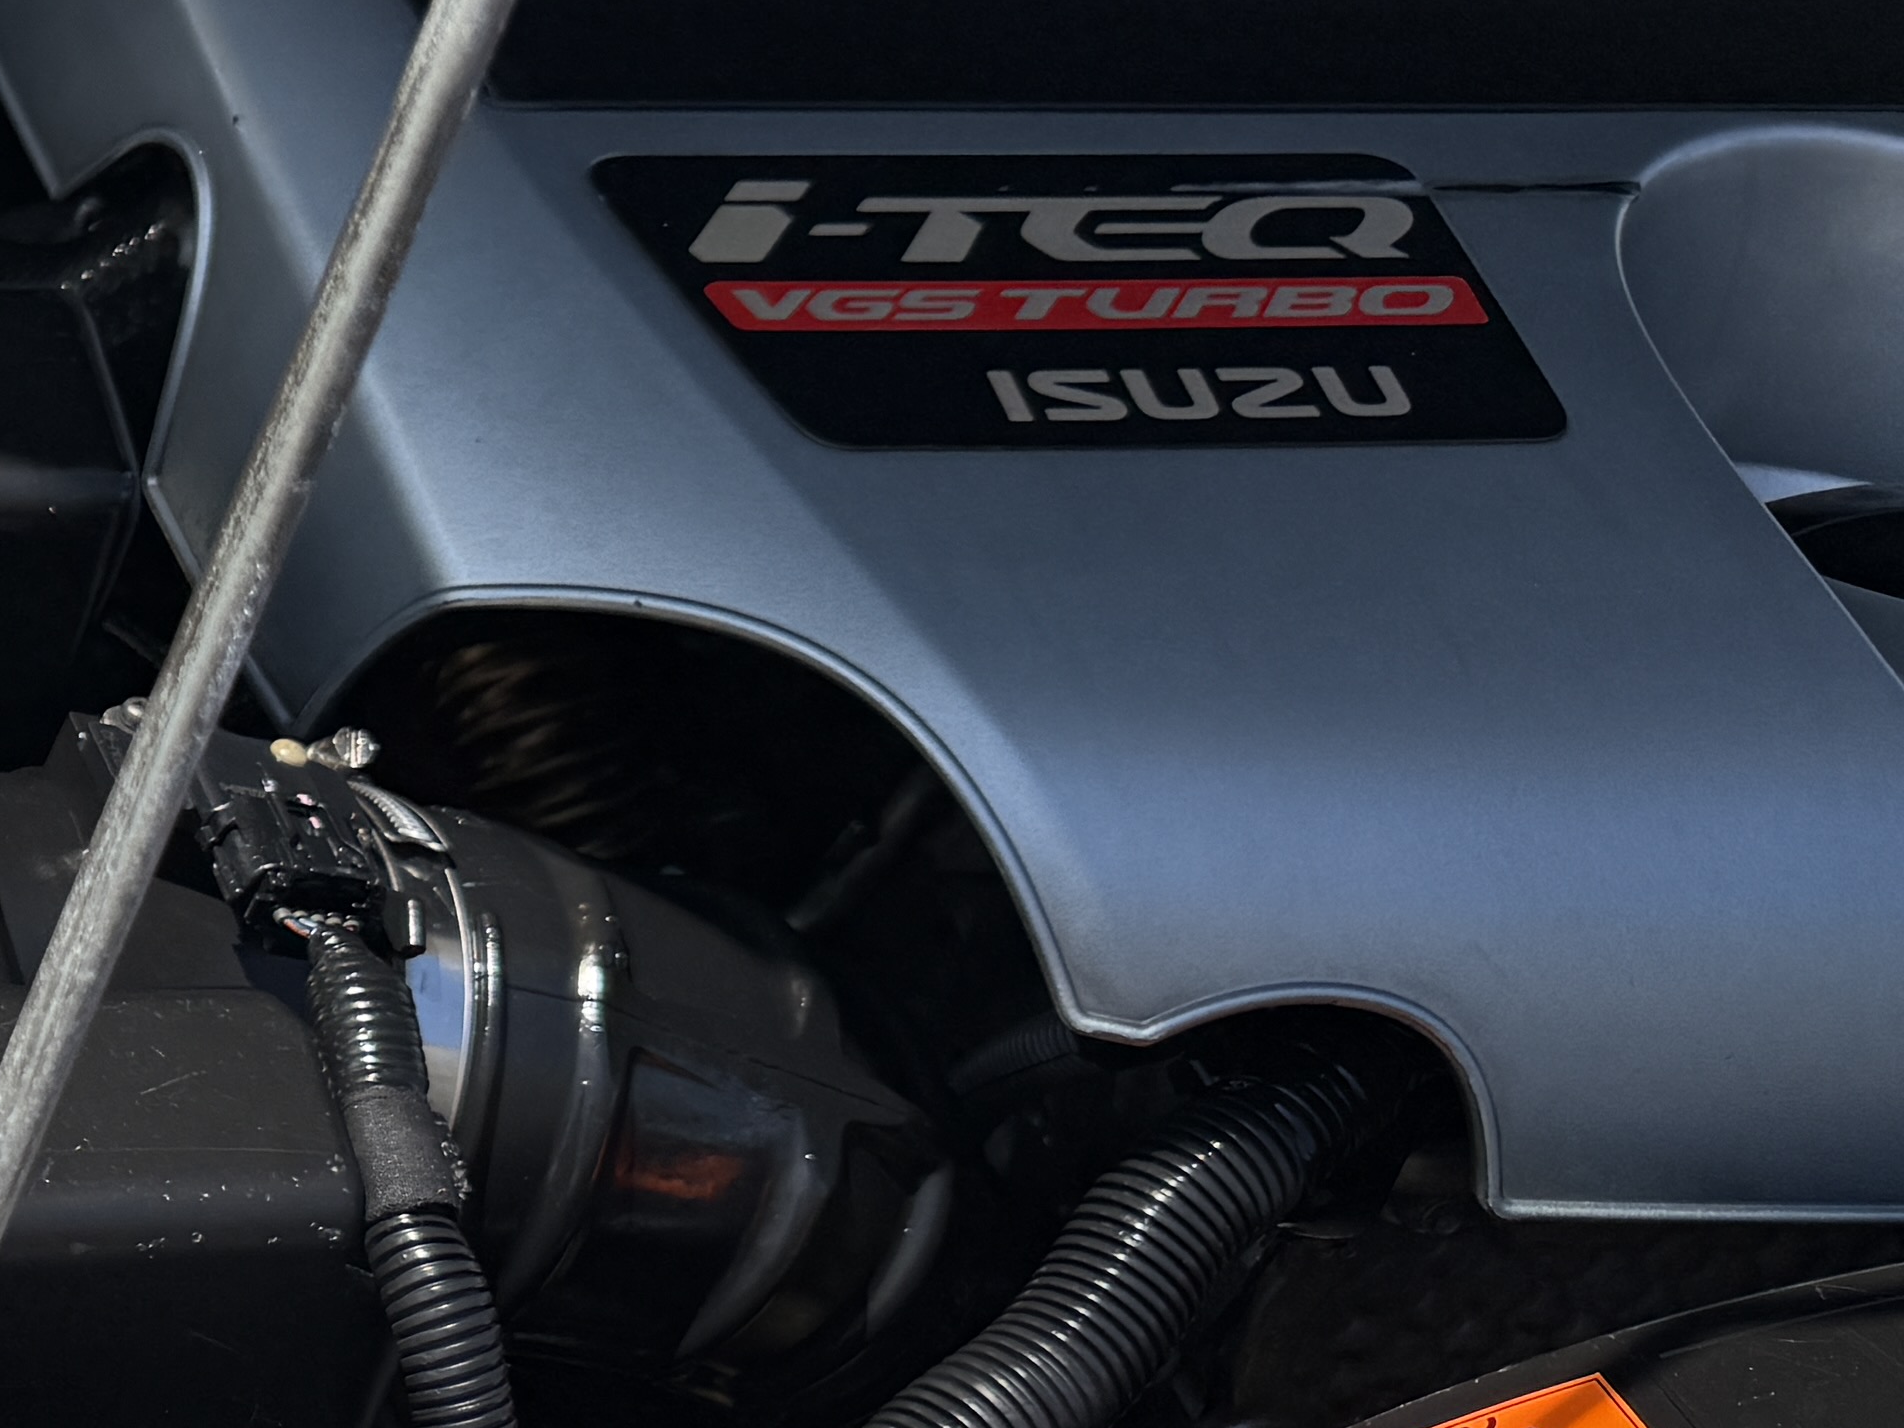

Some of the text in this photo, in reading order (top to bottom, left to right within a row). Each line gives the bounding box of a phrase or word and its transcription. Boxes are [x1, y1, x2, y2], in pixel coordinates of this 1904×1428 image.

[731, 283, 1456, 322] VGS TURBO
[986, 364, 1413, 424] ISUZU
